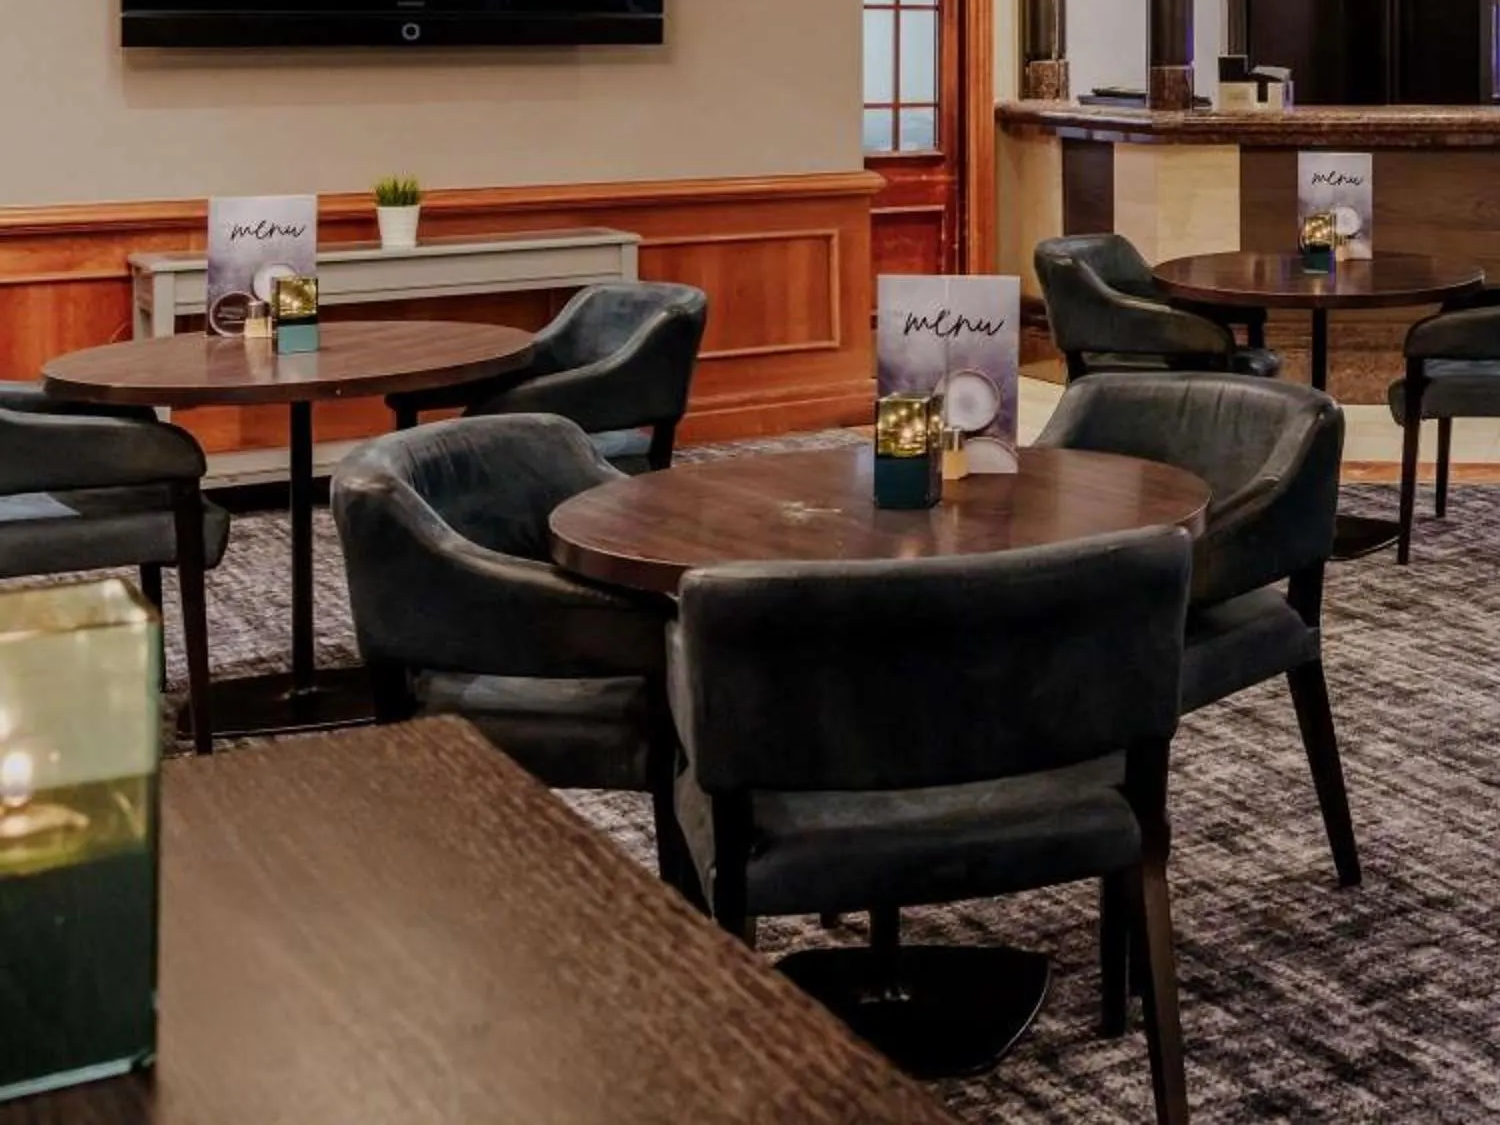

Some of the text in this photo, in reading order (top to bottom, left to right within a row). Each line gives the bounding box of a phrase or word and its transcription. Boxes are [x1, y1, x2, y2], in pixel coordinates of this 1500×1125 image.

[1311, 170, 1364, 187] menu
[230, 219, 307, 241] menu
[903, 308, 1005, 337] menu
